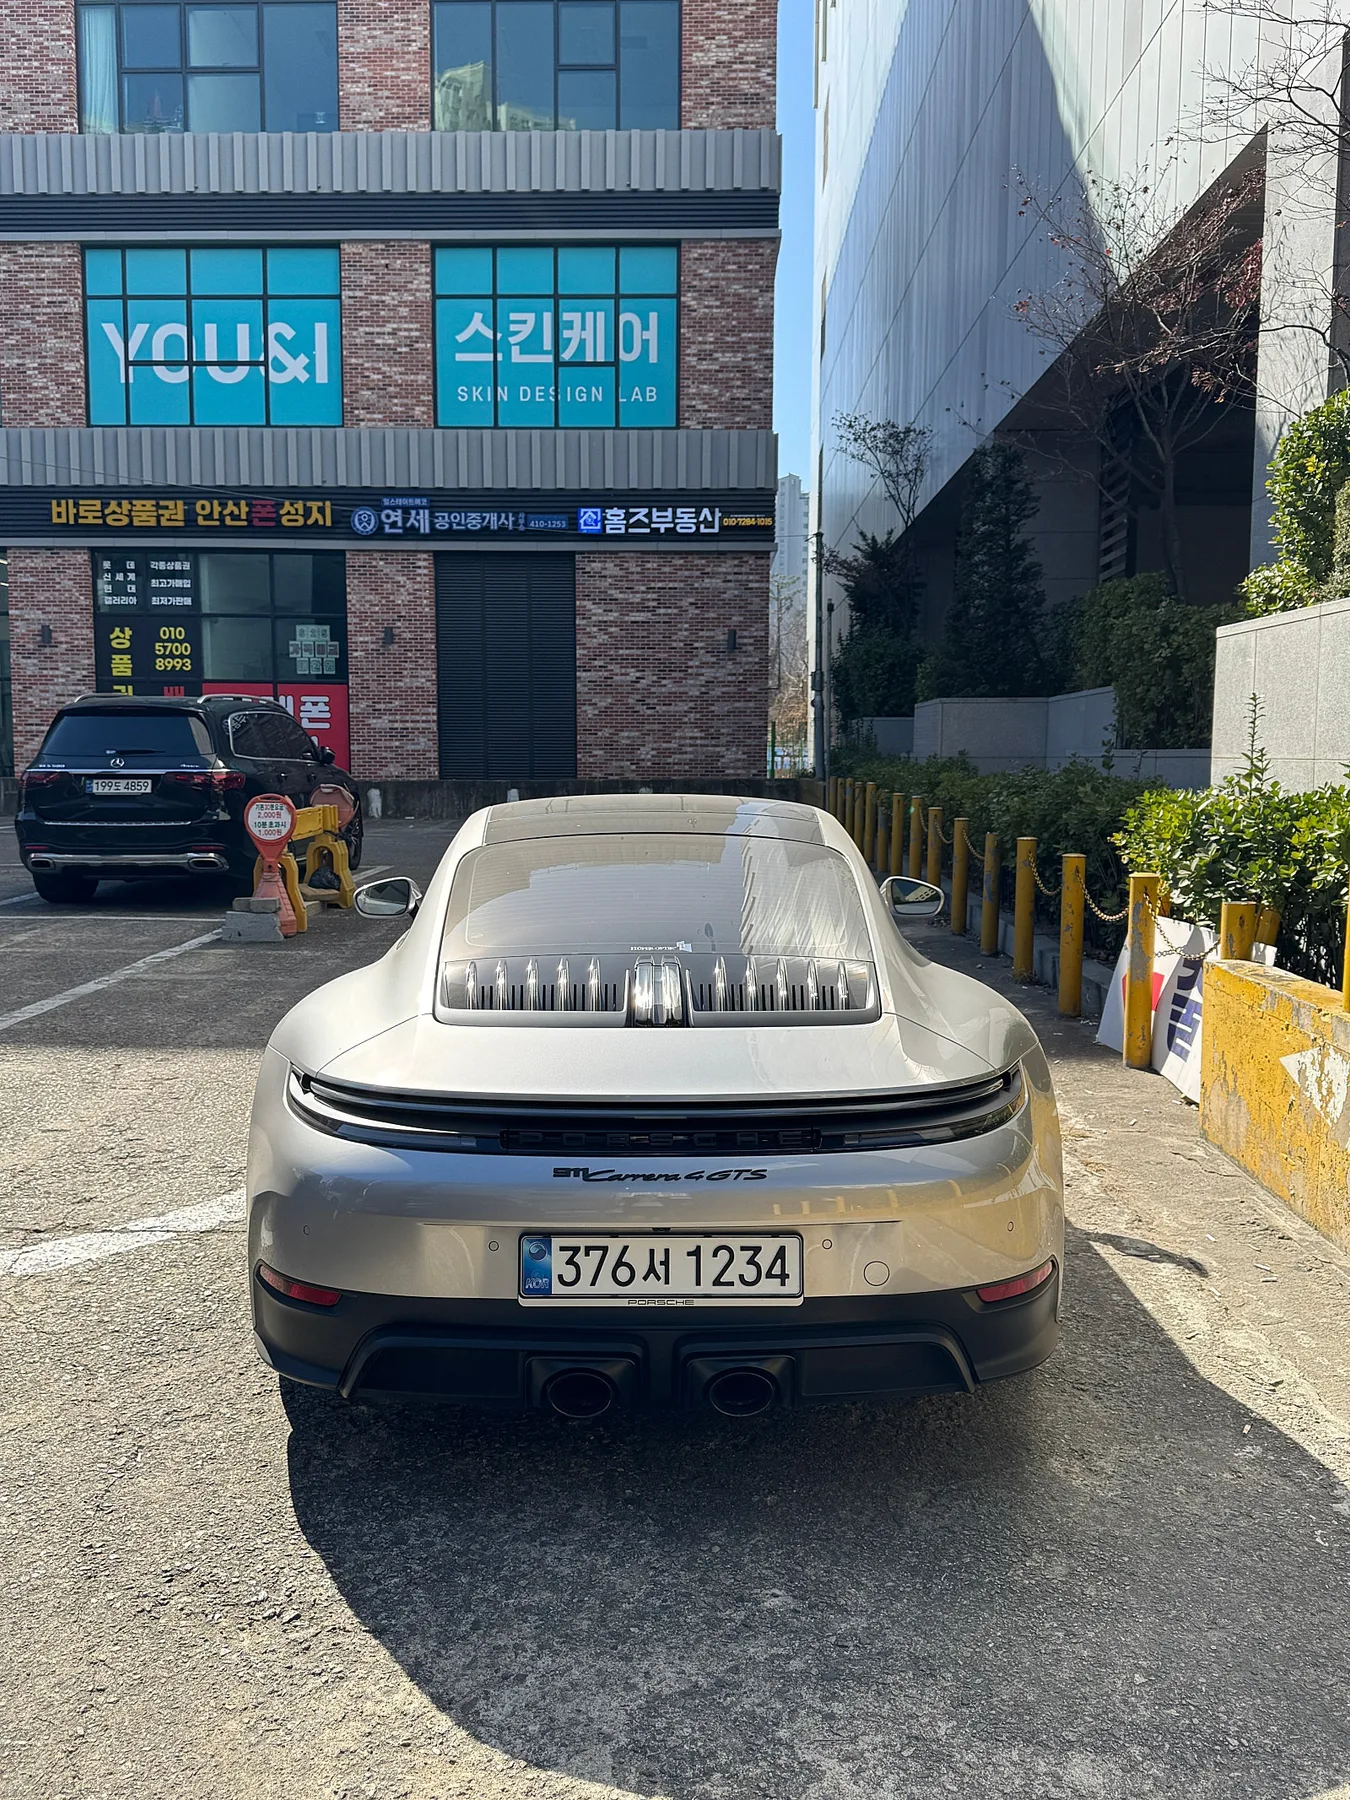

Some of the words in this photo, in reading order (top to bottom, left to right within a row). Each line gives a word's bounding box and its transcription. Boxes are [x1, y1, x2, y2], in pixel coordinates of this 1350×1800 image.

[455, 312, 658, 363] 스킨케어
[101, 322, 328, 384] YOU&I
[457, 386, 508, 402] SKIN
[519, 386, 603, 402] DESIGN
[619, 387, 657, 402] LAB
[51, 499, 185, 527] 바로상품권
[195, 500, 332, 527] 안산폰성지
[604, 507, 722, 533] 홈즈부동산
[380, 508, 430, 534] 연세
[434, 512, 515, 530] 공인중개사
[529, 520, 567, 529] 410-1253
[150, 579, 192, 588] 최고가매입
[104, 596, 138, 605] 갤러리아
[151, 597, 192, 606] 최저가판매
[159, 626, 186, 640] 010
[154, 642, 192, 656] 5700
[154, 658, 192, 671] 8993
[94, 781, 122, 791] 199도
[123, 781, 150, 791] 4859
[518, 1131, 804, 1148] PORSCHE
[552, 1167, 589, 1178] 911
[583, 1169, 682, 1182] Carrera
[684, 1170, 706, 1180] 4
[706, 1168, 768, 1181] GTS
[557, 1245, 671, 1288] 376서
[686, 1245, 791, 1287] 1234
[525, 1277, 549, 1289] KOR
